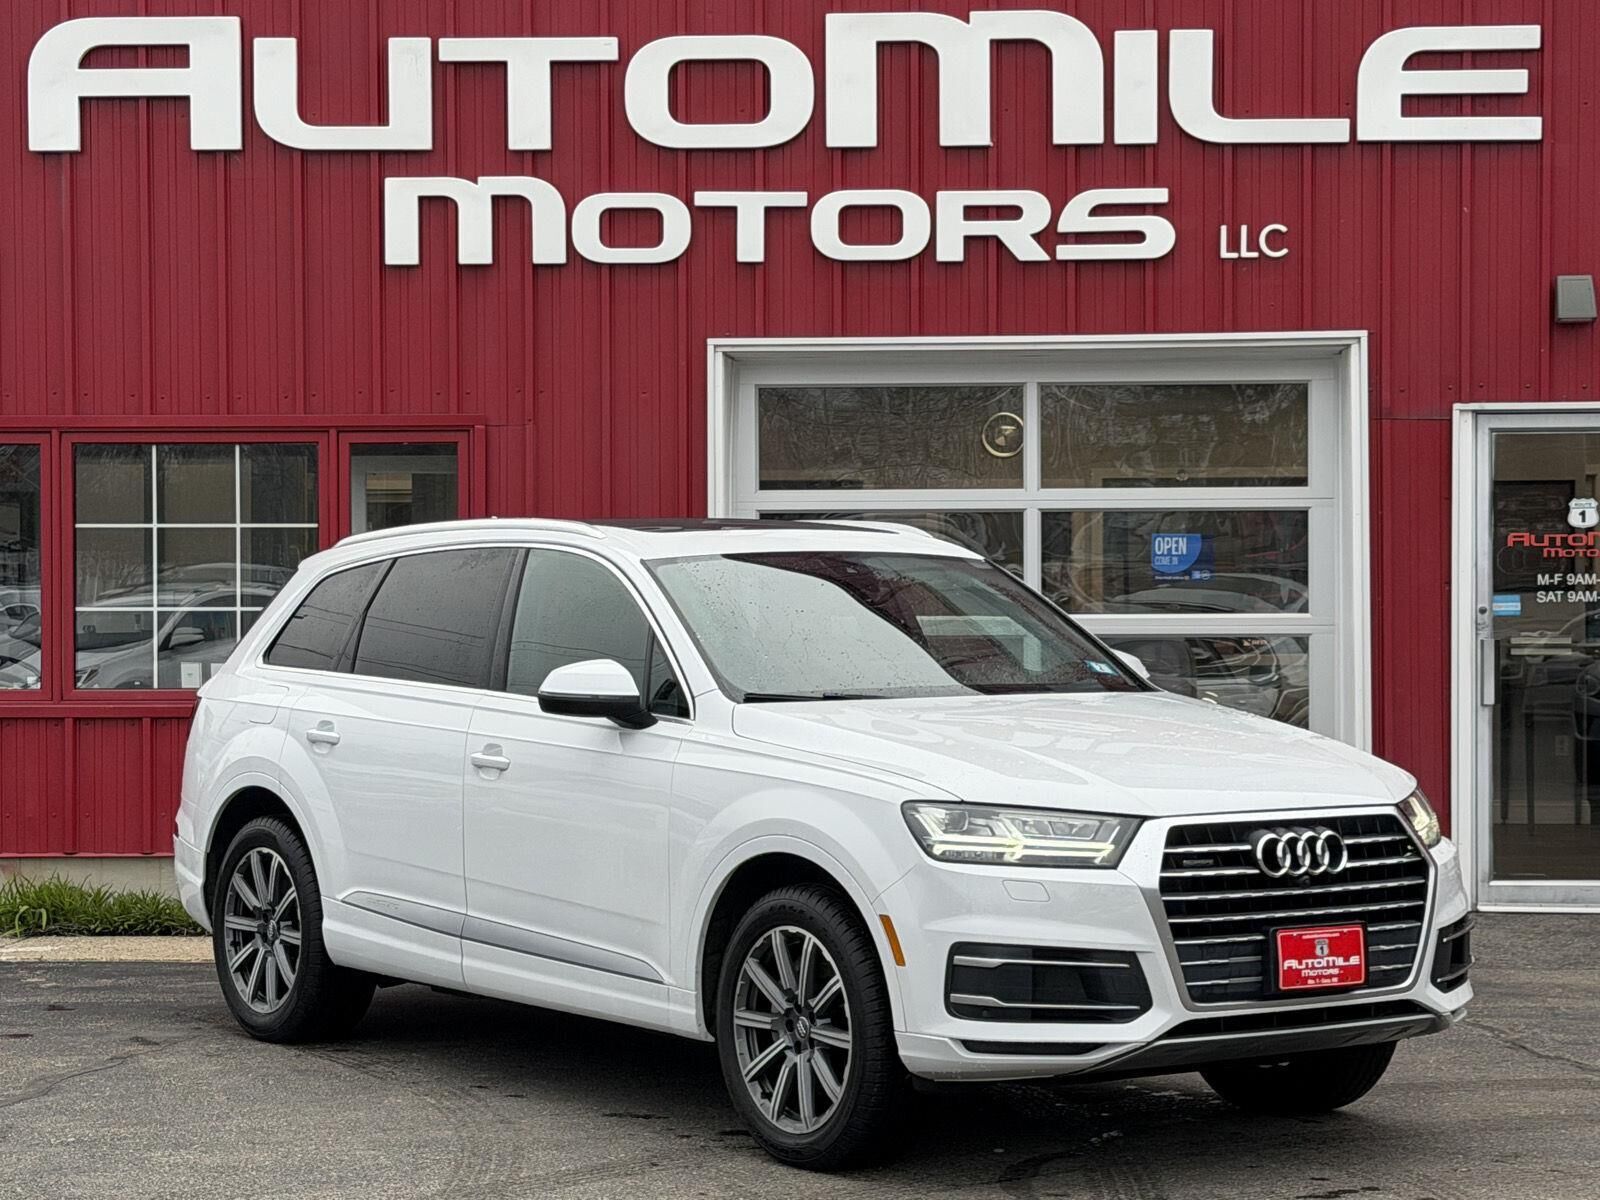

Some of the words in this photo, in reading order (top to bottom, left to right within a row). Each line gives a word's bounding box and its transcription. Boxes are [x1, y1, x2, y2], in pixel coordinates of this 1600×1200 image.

[384, 175, 1176, 265] MOTORS
[1220, 223, 1289, 259] LLC
[1578, 509, 1586, 523] 1
[1155, 537, 1187, 555] OPEN
[1537, 573, 1563, 586] M-F
[1536, 590, 1564, 603] SAT
[1301, 968, 1339, 977] MOTORS
